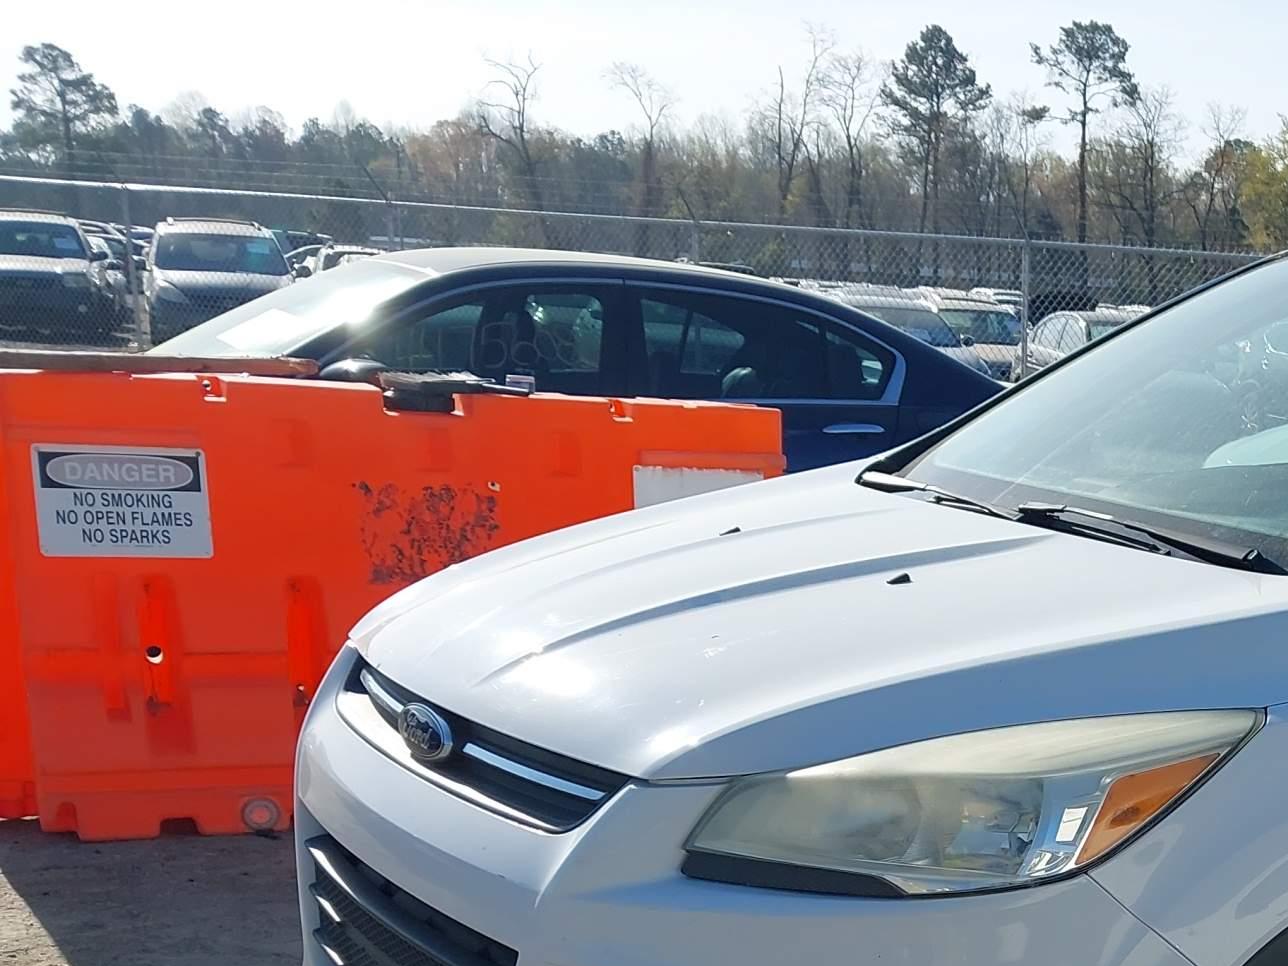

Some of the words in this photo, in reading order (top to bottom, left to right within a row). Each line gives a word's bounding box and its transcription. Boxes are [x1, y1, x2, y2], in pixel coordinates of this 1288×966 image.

[63, 461, 176, 482] DANGER
[73, 492, 96, 507] NO
[100, 493, 173, 509] SMOKING
[56, 510, 78, 525] NO
[83, 510, 126, 526] OPEN
[131, 511, 193, 527] FLAMES
[82, 528, 104, 543] NO
[109, 529, 171, 544] SPARKS
